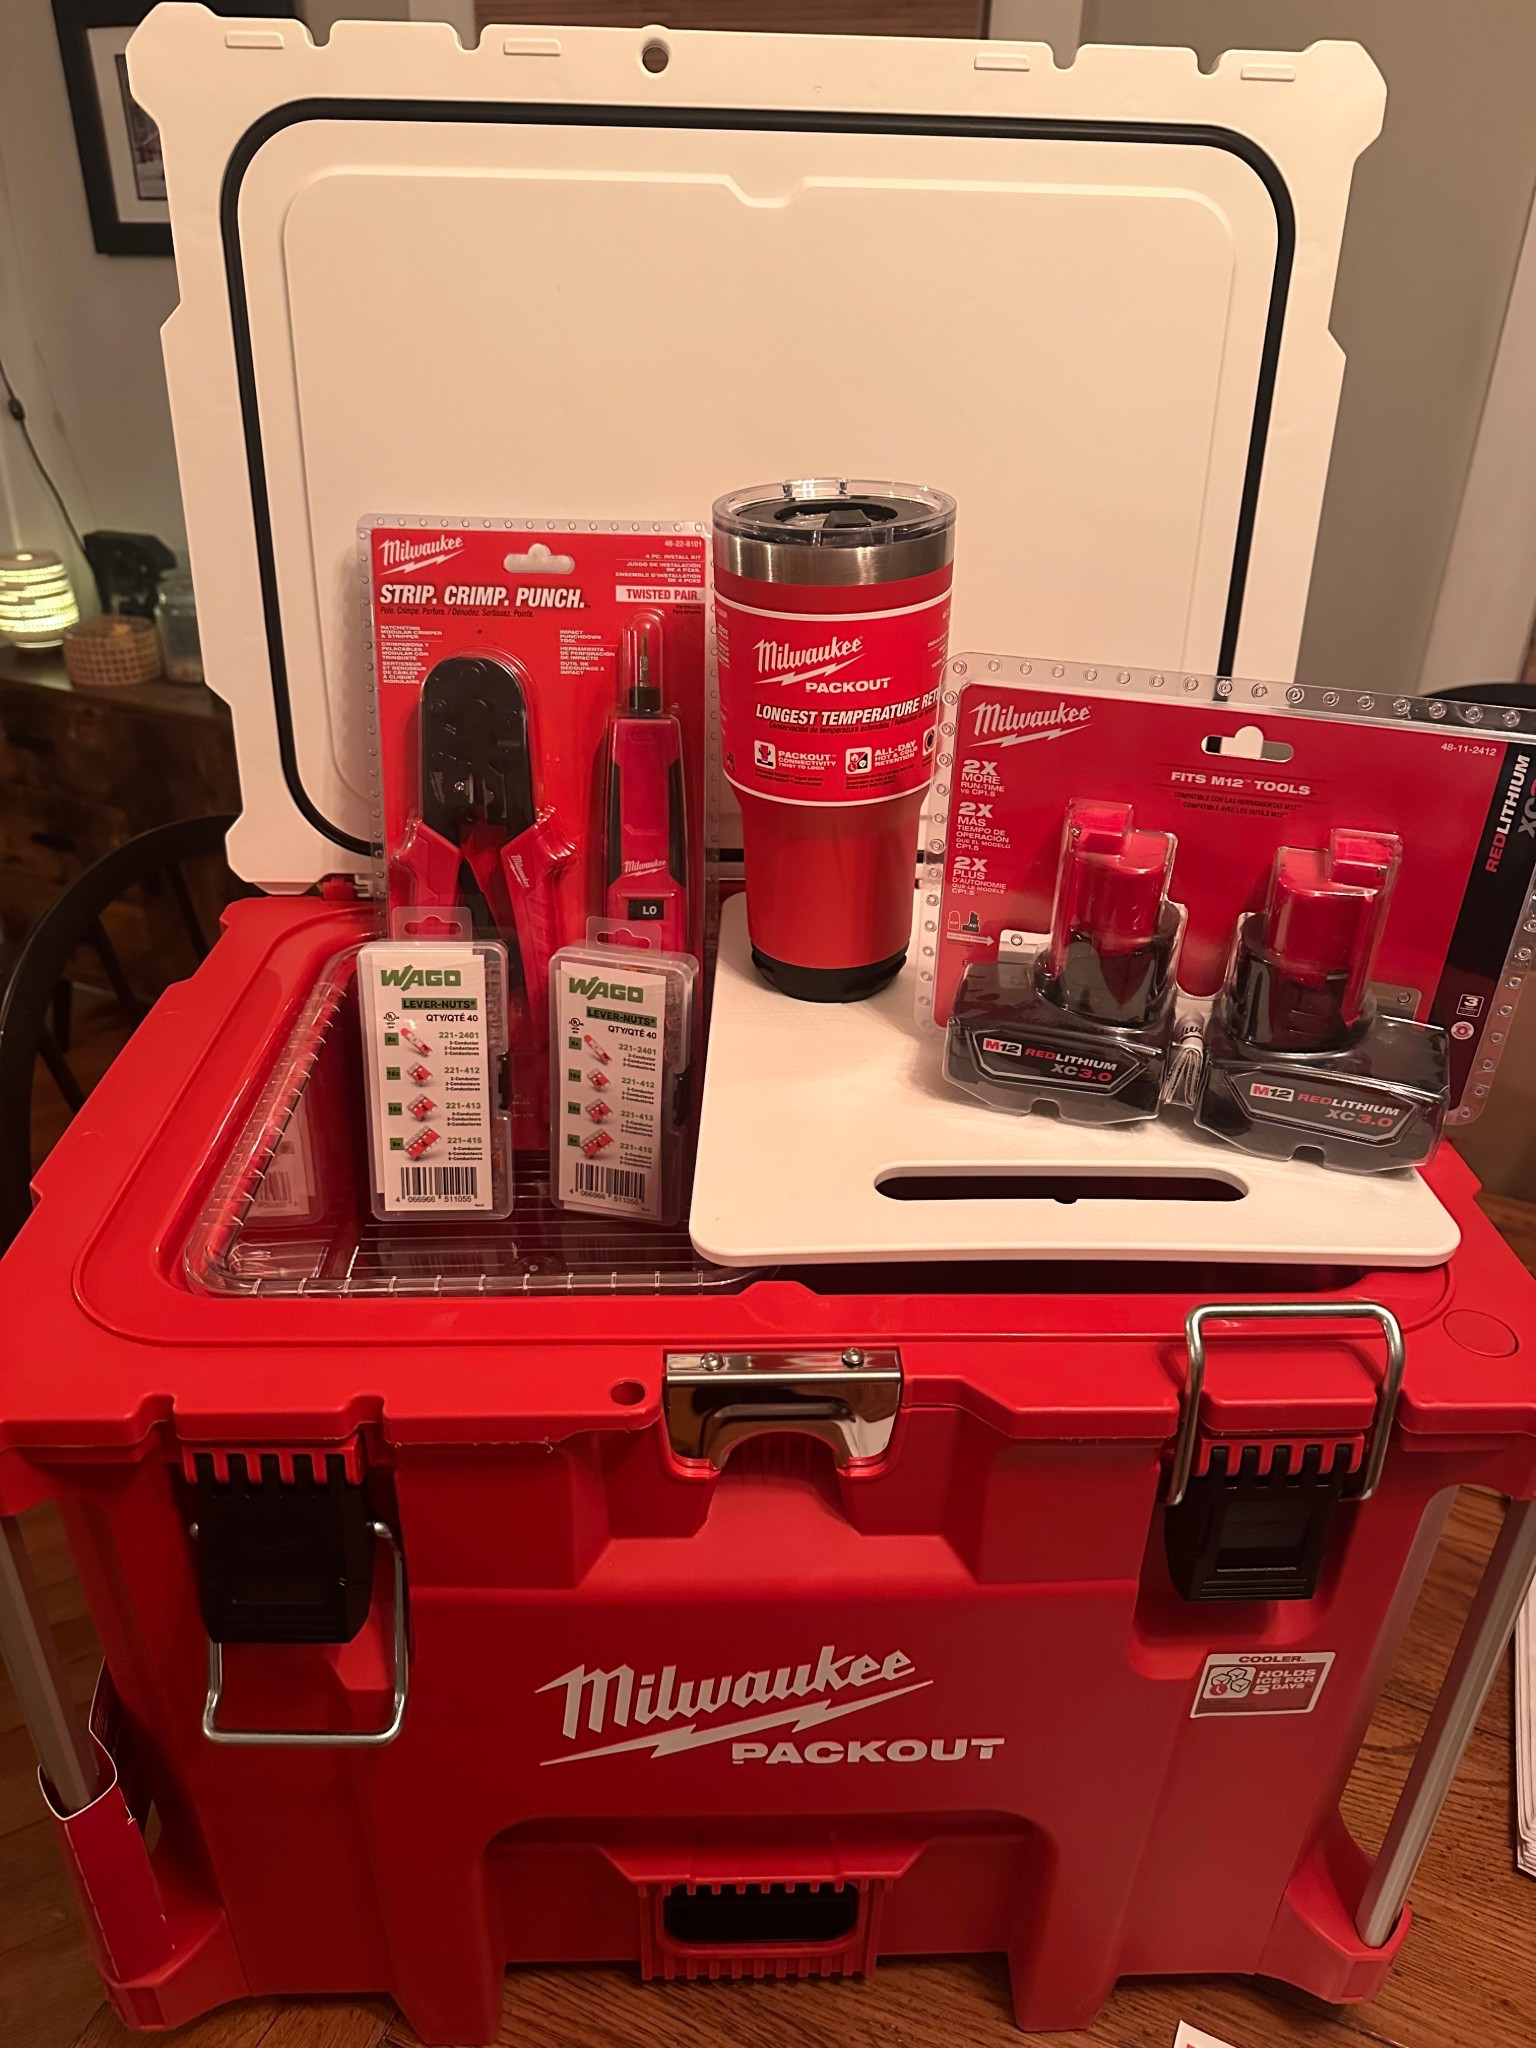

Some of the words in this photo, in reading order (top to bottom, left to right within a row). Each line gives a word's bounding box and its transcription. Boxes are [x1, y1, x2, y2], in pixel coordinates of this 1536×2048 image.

[378, 535, 463, 566] Milwaukee
[380, 584, 437, 605] STRIP.
[444, 586, 509, 606] CRIMP.
[516, 588, 585, 608] PUNCH.
[626, 589, 670, 599] TWISTED
[753, 637, 863, 674] Milwaukee
[806, 678, 891, 693] PACKOUT
[756, 704, 818, 725] LONGEST
[821, 697, 920, 726] TEMPERATURE
[969, 702, 1091, 736] Milwaukee
[874, 740, 916, 756] ALL-DAY
[900, 746, 917, 755] COLD
[1441, 743, 1497, 756] 48-11-2412
[778, 751, 831, 761] PACKOUT
[778, 758, 836, 766] CONNECTIVITY
[875, 753, 914, 766] RETENTION
[962, 760, 998, 776] 2X
[962, 773, 1000, 784] MORE
[1171, 772, 1206, 783] FITS
[1254, 780, 1311, 795] TOOLS
[961, 781, 1005, 792] RUN-TIME
[972, 789, 996, 797] CP1.5
[1174, 792, 1210, 801] COMPATIBLE
[1237, 799, 1283, 809] HERRAMIENTAS
[959, 802, 994, 818] 2X
[1183, 802, 1219, 812] COMPATIBLE
[1220, 805, 1235, 813] AVEC
[1485, 755, 1530, 873] REDLITHIUM
[958, 816, 986, 827] MÁS
[957, 824, 991, 834] TIEMPO
[956, 831, 1009, 843] OPERACIÓN
[981, 841, 1010, 849] MODELO
[511, 854, 530, 887] Milwaukee
[624, 859, 667, 873] Milwaukee
[954, 856, 988, 872] 2X
[953, 869, 985, 880] PLUS
[952, 877, 1006, 889] D'AUTONOMIE
[643, 906, 657, 914] LO
[381, 965, 461, 991] WAGO
[569, 976, 643, 1003] WAGO
[1464, 997, 1479, 1006] 3
[426, 1013, 465, 1022] QTY/QTÉ
[608, 1025, 645, 1037] QTY/QTÉ
[619, 1043, 656, 1055] 221-2401
[985, 1039, 1020, 1053] M12
[1025, 1048, 1117, 1071] REDLITHIUM
[1051, 1063, 1112, 1082] XC3.0
[621, 1078, 654, 1088] 221-412
[1253, 1085, 1292, 1099] M12
[1297, 1093, 1400, 1116] REDLITHIUM
[621, 1110, 653, 1121] 221-413
[1325, 1109, 1393, 1127] XC3.0
[1258, 1669, 1317, 1677] HOLDS
[1256, 1677, 1282, 1685] ICE
[534, 1645, 915, 1740] Milwaukee
[1252, 1684, 1270, 1695] 5
[732, 1737, 1004, 1765] PACKOUT
